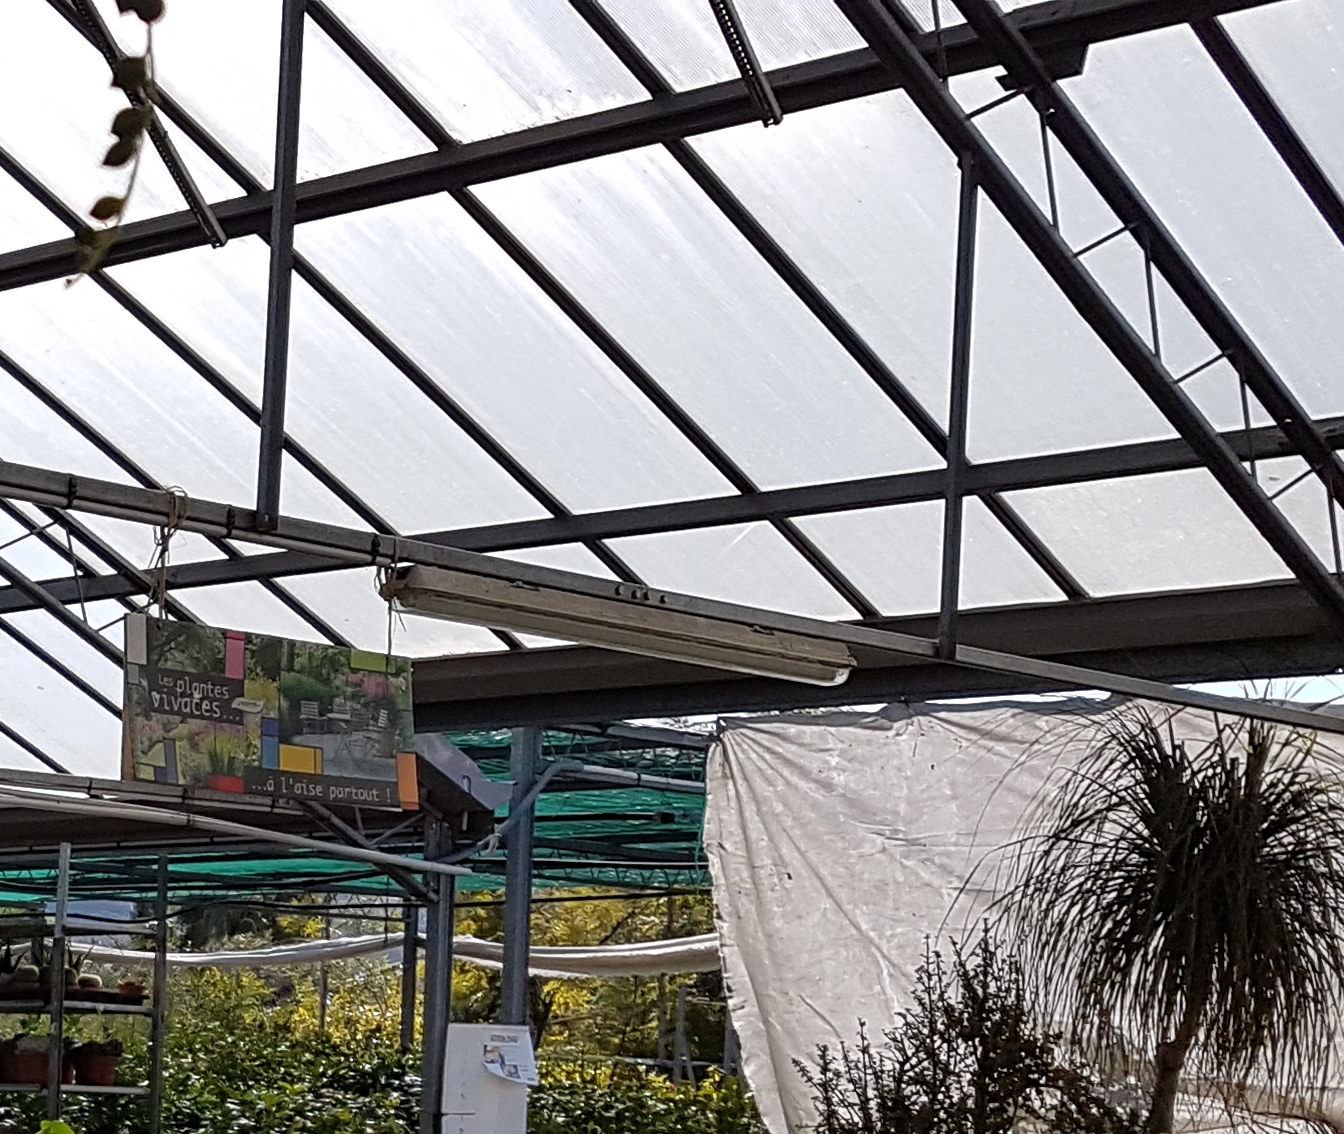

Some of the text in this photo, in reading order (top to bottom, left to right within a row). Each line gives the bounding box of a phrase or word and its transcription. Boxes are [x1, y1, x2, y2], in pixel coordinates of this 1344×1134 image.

[158, 674, 230, 699] Les plantes
[281, 777, 324, 798] l'aise
[329, 785, 380, 802] partout
